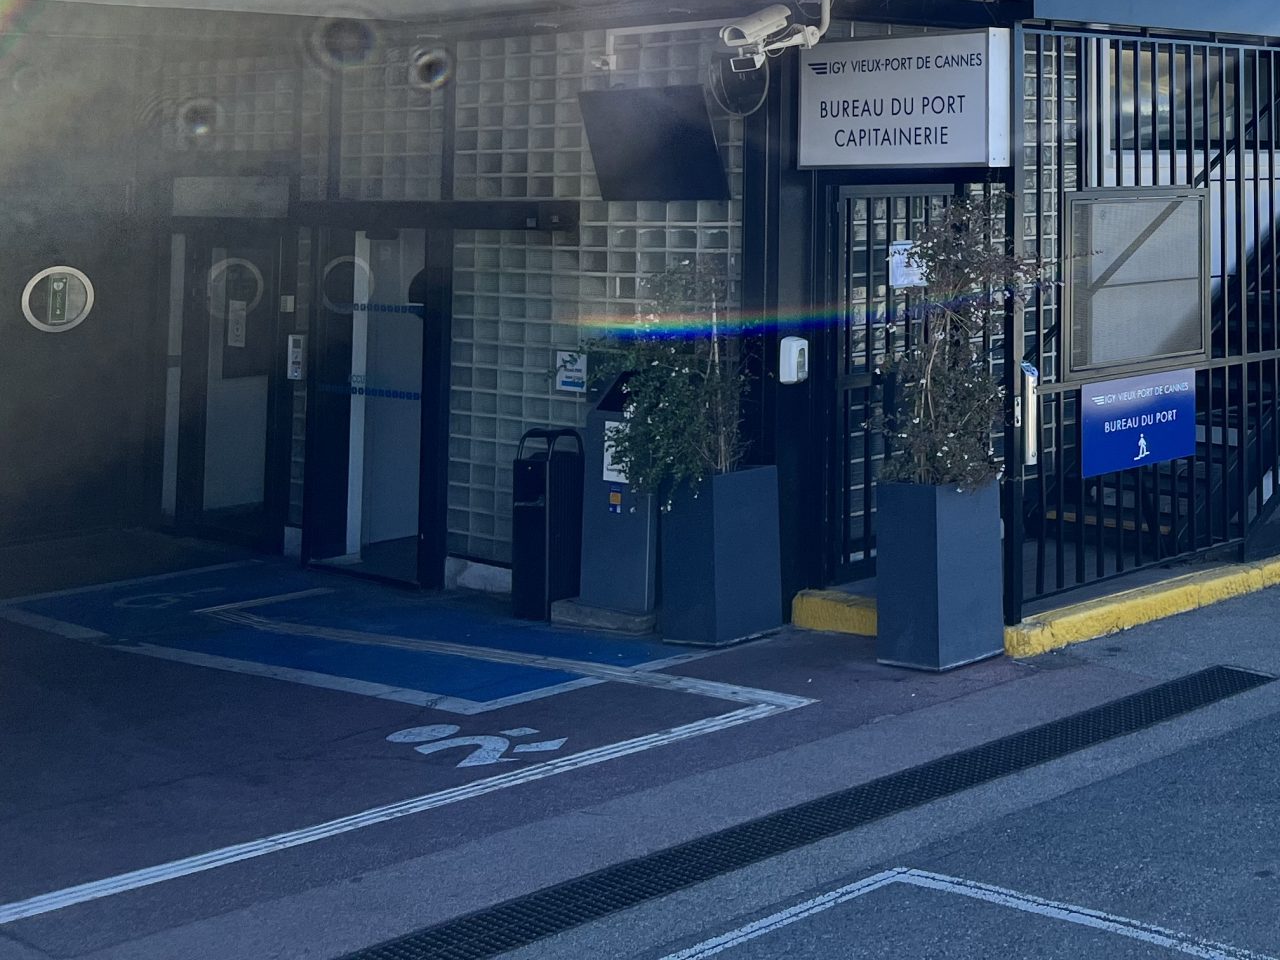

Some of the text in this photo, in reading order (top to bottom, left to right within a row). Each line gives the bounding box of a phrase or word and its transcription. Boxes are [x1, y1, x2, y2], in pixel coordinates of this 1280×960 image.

[829, 52, 983, 75] IGY VIEUX-PORT DE CANNES
[820, 94, 966, 119] BUREAU DU PORT
[834, 126, 949, 148] CAPITAINERIE
[1105, 382, 1189, 404] IGY VIEUX-PORT DE CANNES
[1104, 409, 1177, 433] BUREAU DU PORT
